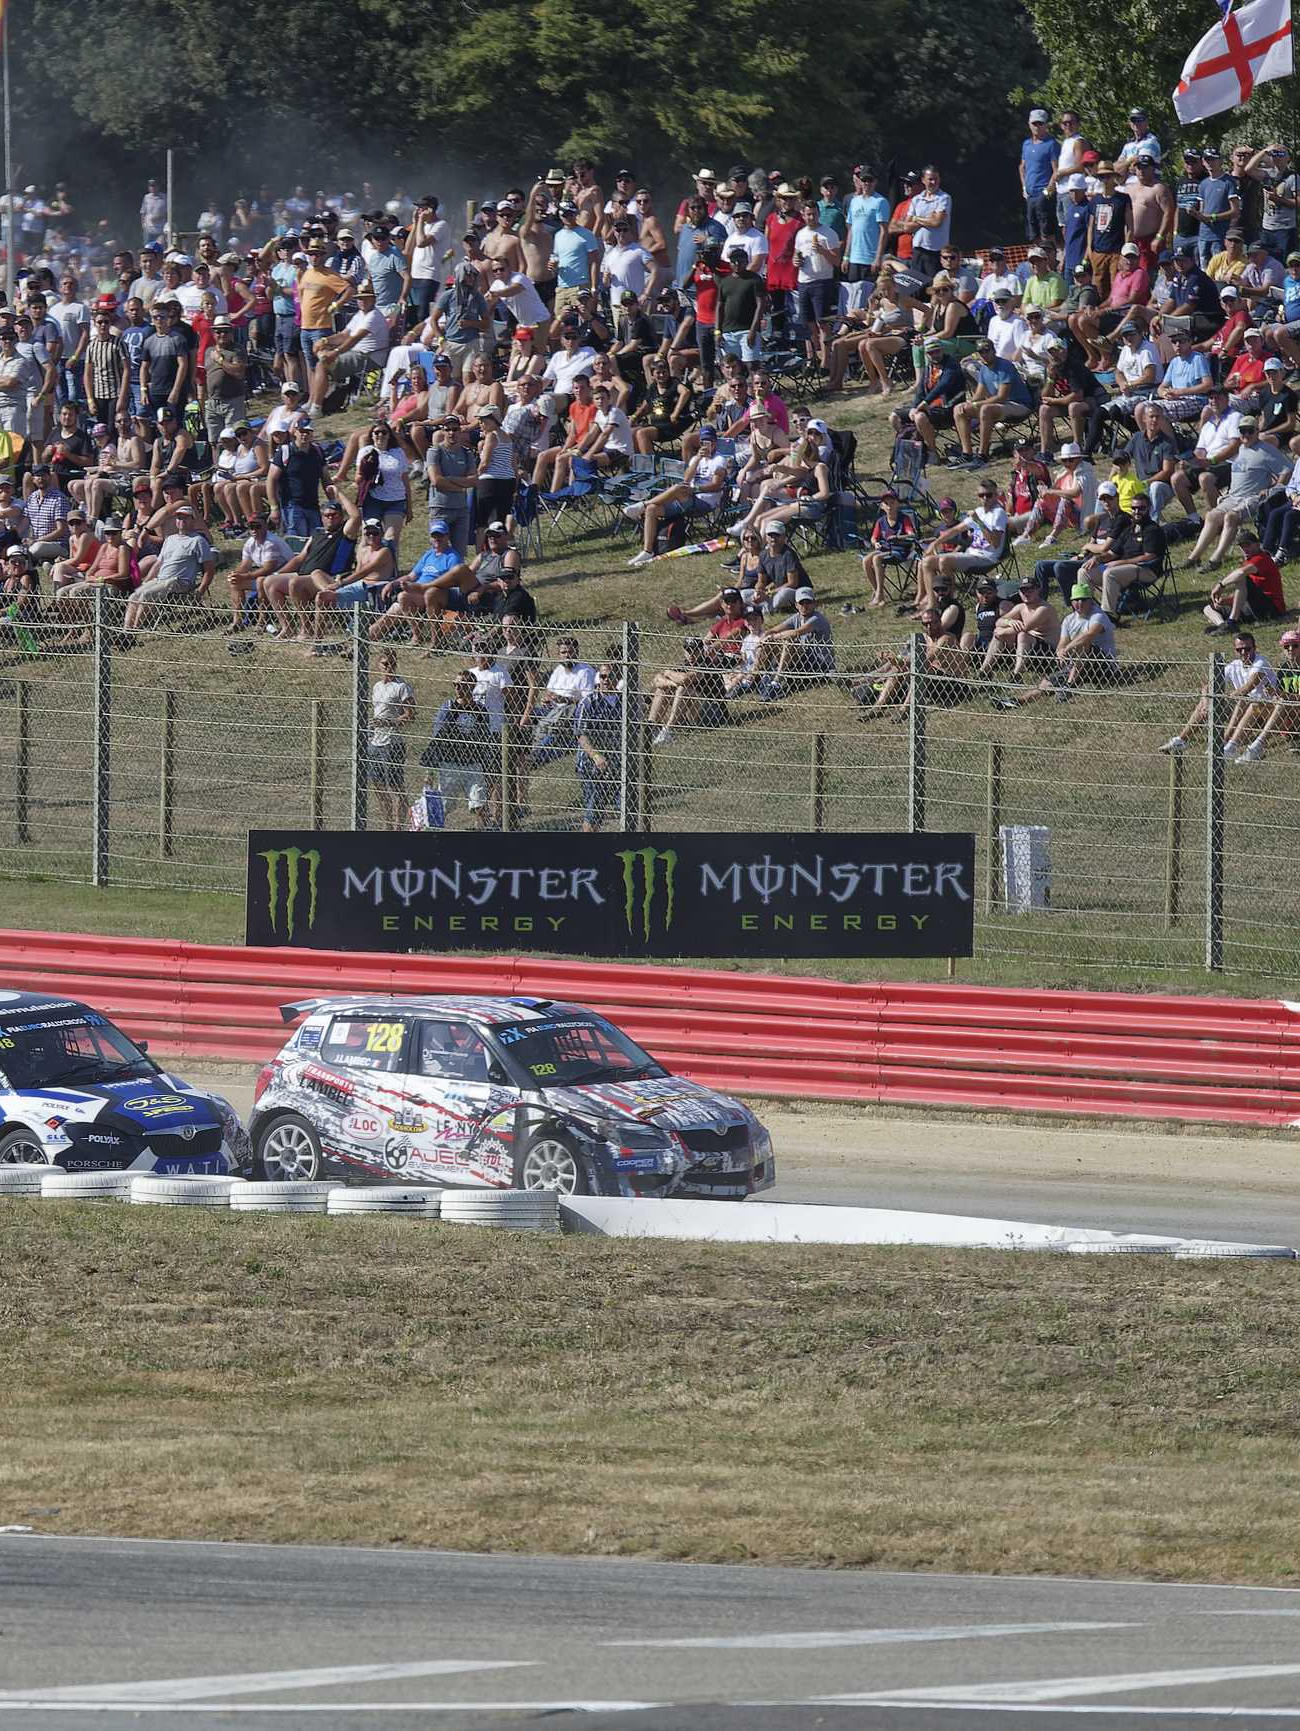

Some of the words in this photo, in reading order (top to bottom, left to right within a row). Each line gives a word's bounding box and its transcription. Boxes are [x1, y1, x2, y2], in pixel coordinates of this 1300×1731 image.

[343, 859, 606, 907] MONSTER
[700, 854, 971, 904] MONSTER
[383, 915, 568, 932] ENERGY
[741, 914, 932, 931] ENERGY
[365, 1023, 405, 1052] 128
[306, 1065, 355, 1091] TRANSPORTS
[529, 1063, 557, 1076] 128
[300, 1077, 353, 1106] LAMBEC
[354, 1117, 378, 1132] LOC
[67, 1160, 124, 1168] PORSCHE
